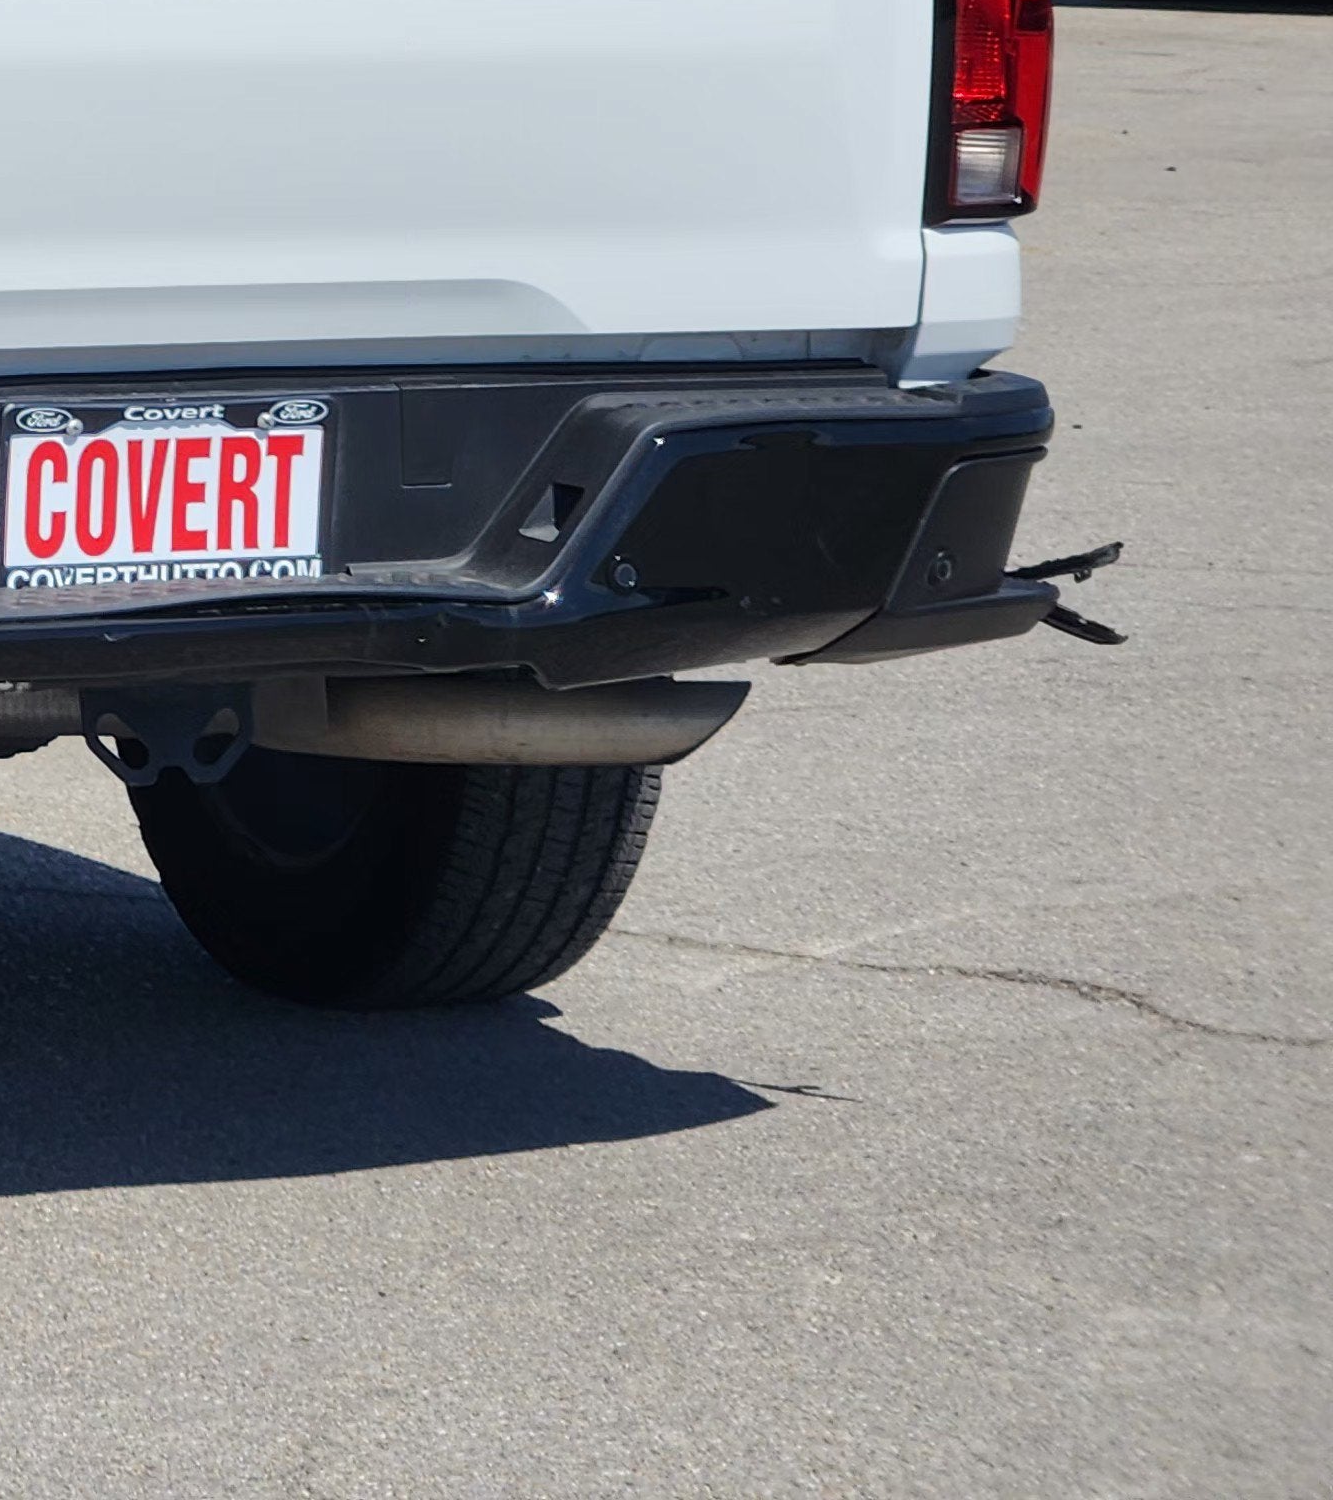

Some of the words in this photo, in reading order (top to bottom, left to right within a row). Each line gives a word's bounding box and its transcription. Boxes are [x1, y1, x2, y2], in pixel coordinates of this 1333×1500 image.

[26, 410, 64, 428] Ford
[123, 404, 226, 421] Covert
[279, 402, 318, 419] Ford
[25, 434, 305, 559] COVERT
[6, 559, 322, 589] COVERTHUTTOCOM
